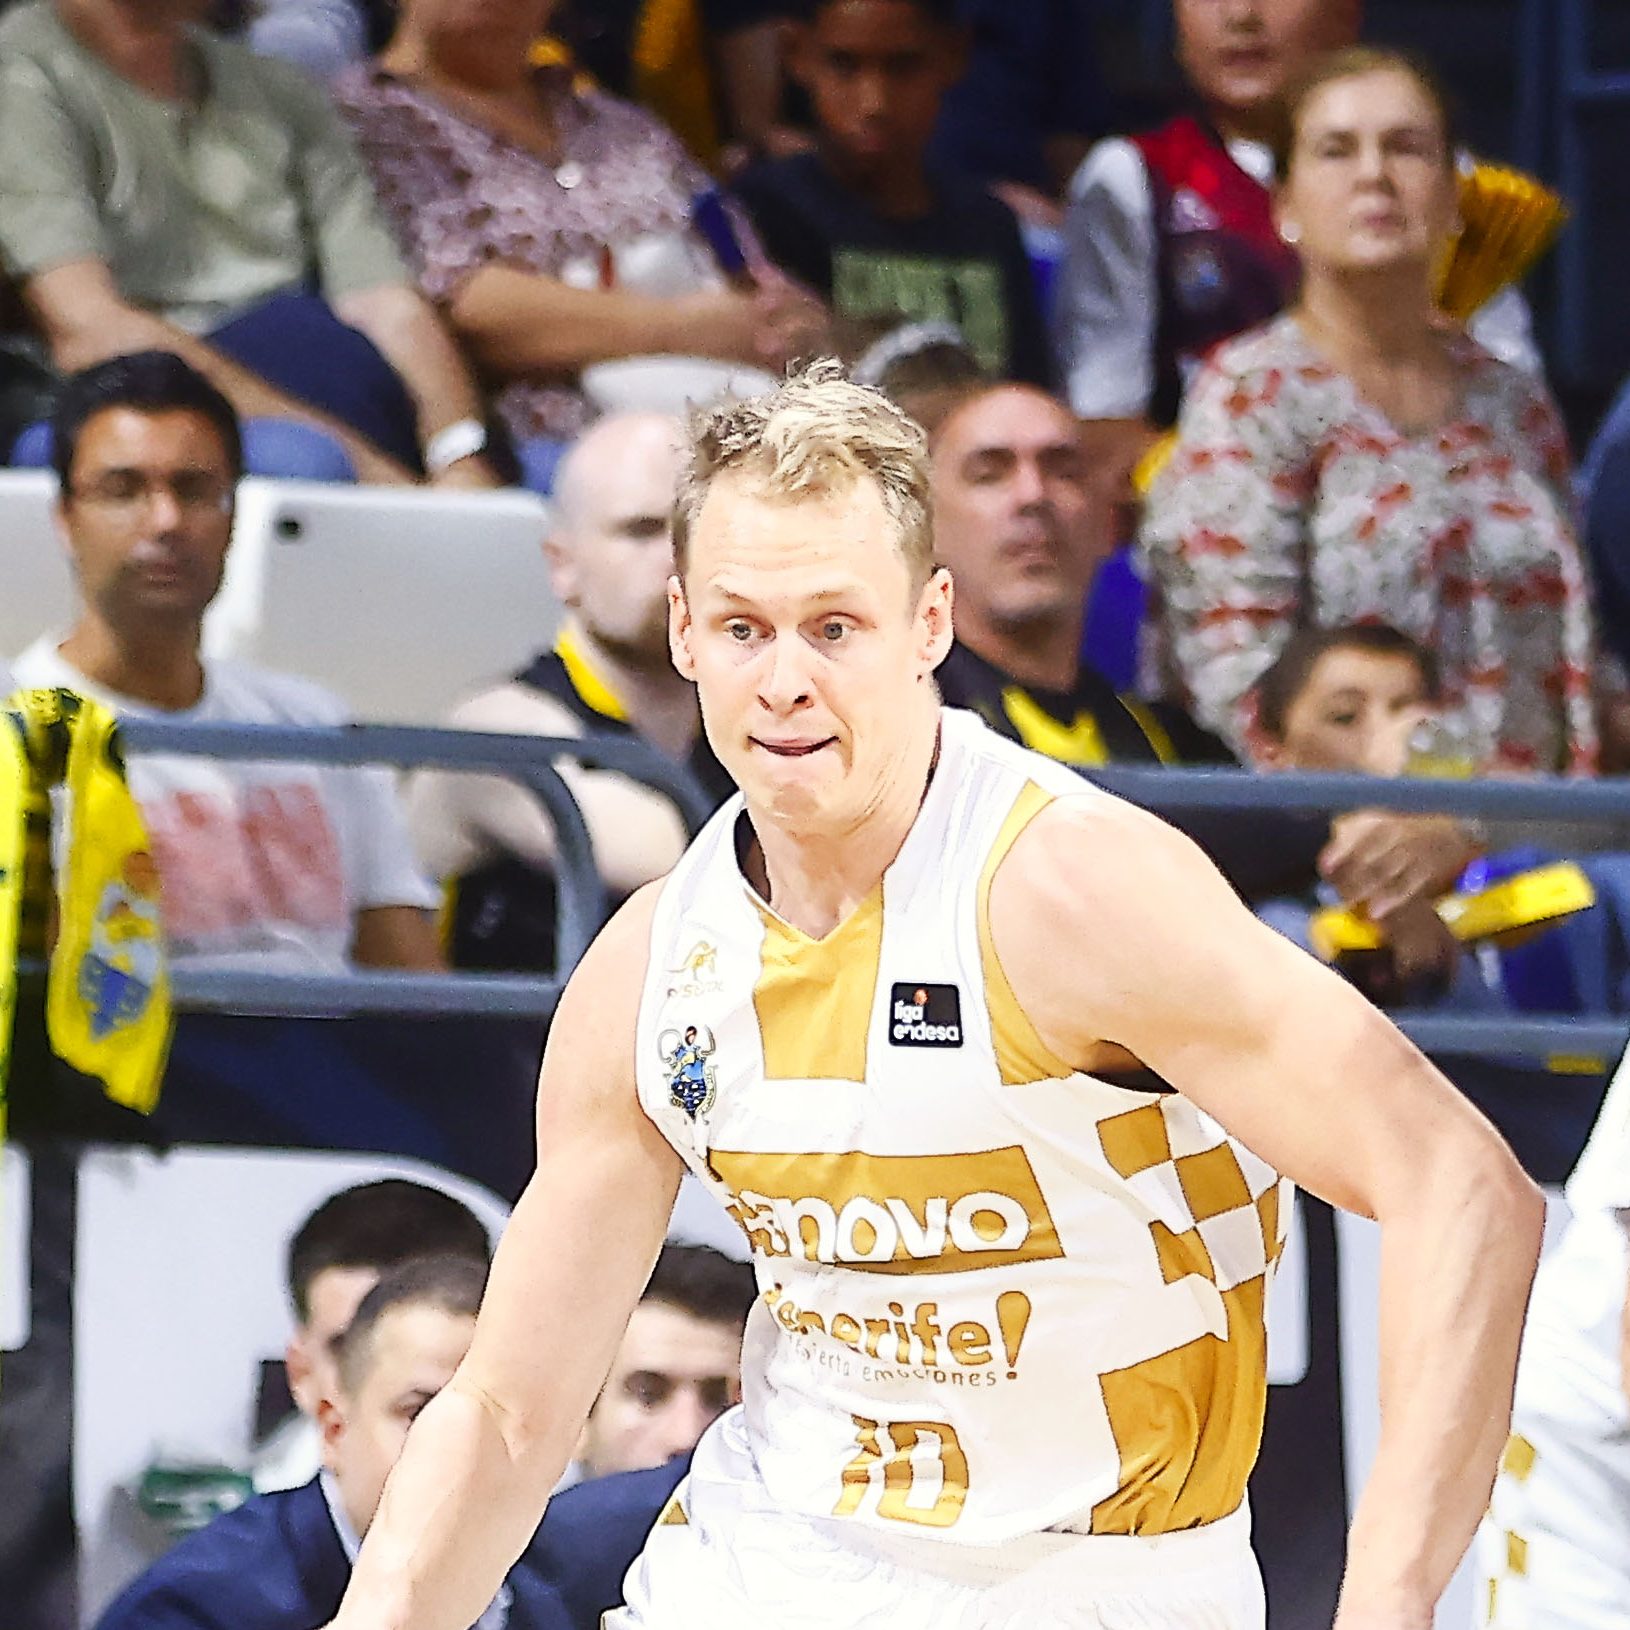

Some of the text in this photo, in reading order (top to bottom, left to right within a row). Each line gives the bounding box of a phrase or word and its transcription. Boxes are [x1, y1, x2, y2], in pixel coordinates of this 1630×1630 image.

[893, 1000, 924, 1024] liga
[893, 1022, 960, 1042] endesa
[832, 1413, 970, 1529] 10
